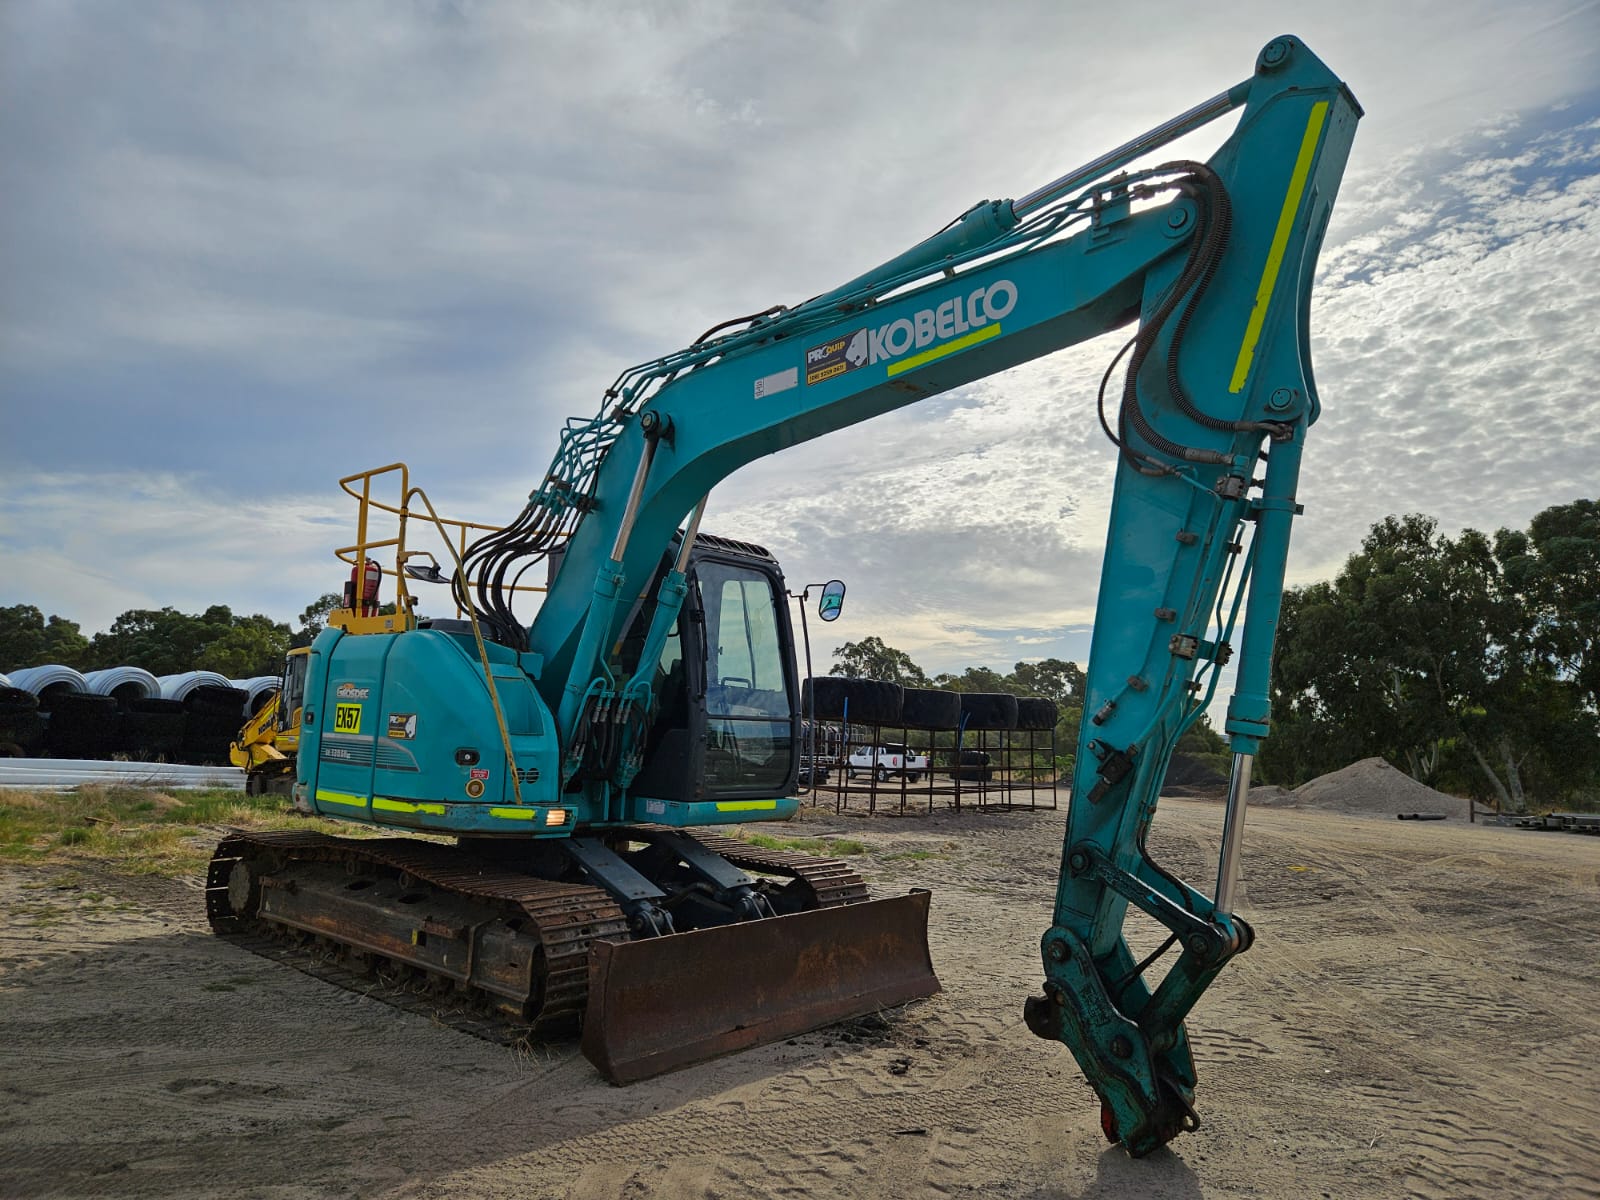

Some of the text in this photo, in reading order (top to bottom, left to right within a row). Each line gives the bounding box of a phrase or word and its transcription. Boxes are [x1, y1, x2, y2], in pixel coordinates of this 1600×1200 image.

[869, 279, 1018, 364] KOBELCO
[808, 341, 846, 364] PROQUIP
[336, 706, 361, 730] EX57
